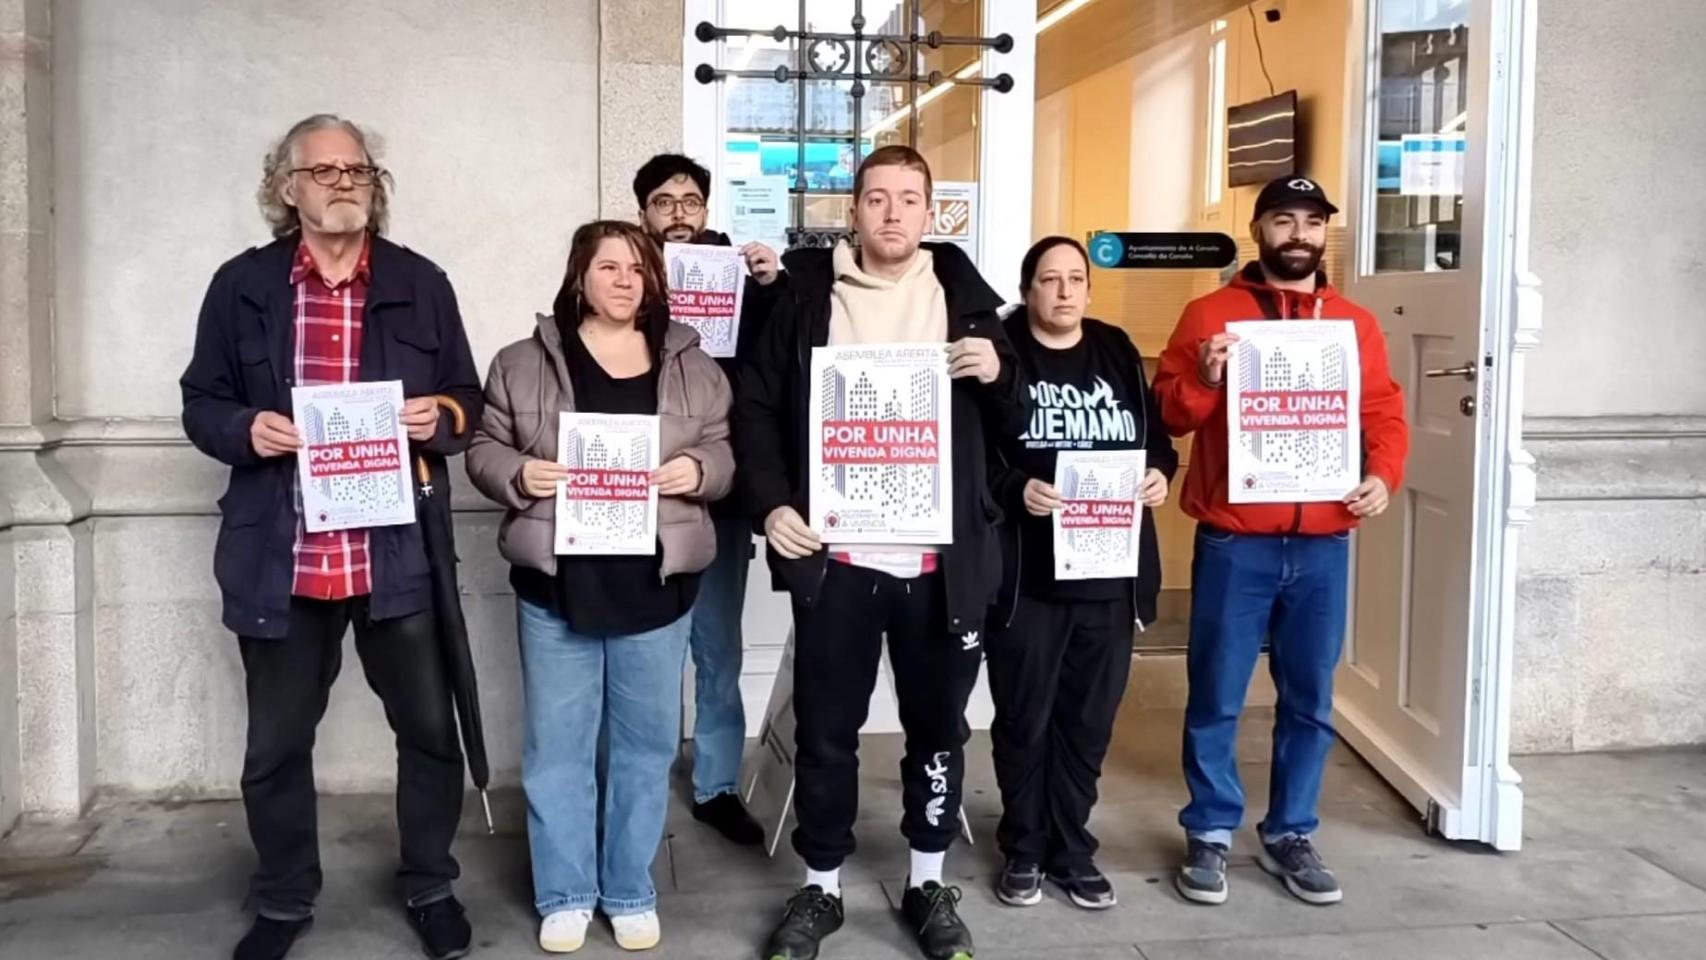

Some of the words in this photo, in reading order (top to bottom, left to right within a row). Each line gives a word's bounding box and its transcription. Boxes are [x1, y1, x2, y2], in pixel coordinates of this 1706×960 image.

[699, 295, 735, 306] UNHA
[1241, 397, 1281, 412] POR
[1287, 396, 1345, 411] UNHA
[1018, 408, 1136, 442] UEMAMO
[1241, 414, 1300, 426] VIVENDA
[1303, 413, 1346, 425] DIGNA
[823, 426, 867, 443] POR
[873, 426, 936, 443] UNHA
[310, 448, 345, 462] POR
[349, 442, 398, 459] UNHA
[823, 447, 887, 459] VIVENDA
[890, 446, 937, 458] DIGNA
[311, 460, 361, 473] VIVENDA
[364, 458, 400, 468] DIGNA
[567, 474, 599, 486] POR
[603, 474, 647, 487] UNHA
[567, 487, 612, 497] VIVENDA
[614, 488, 648, 498] DIGNA
[1061, 503, 1089, 514] POR
[1093, 503, 1133, 516] UNHA
